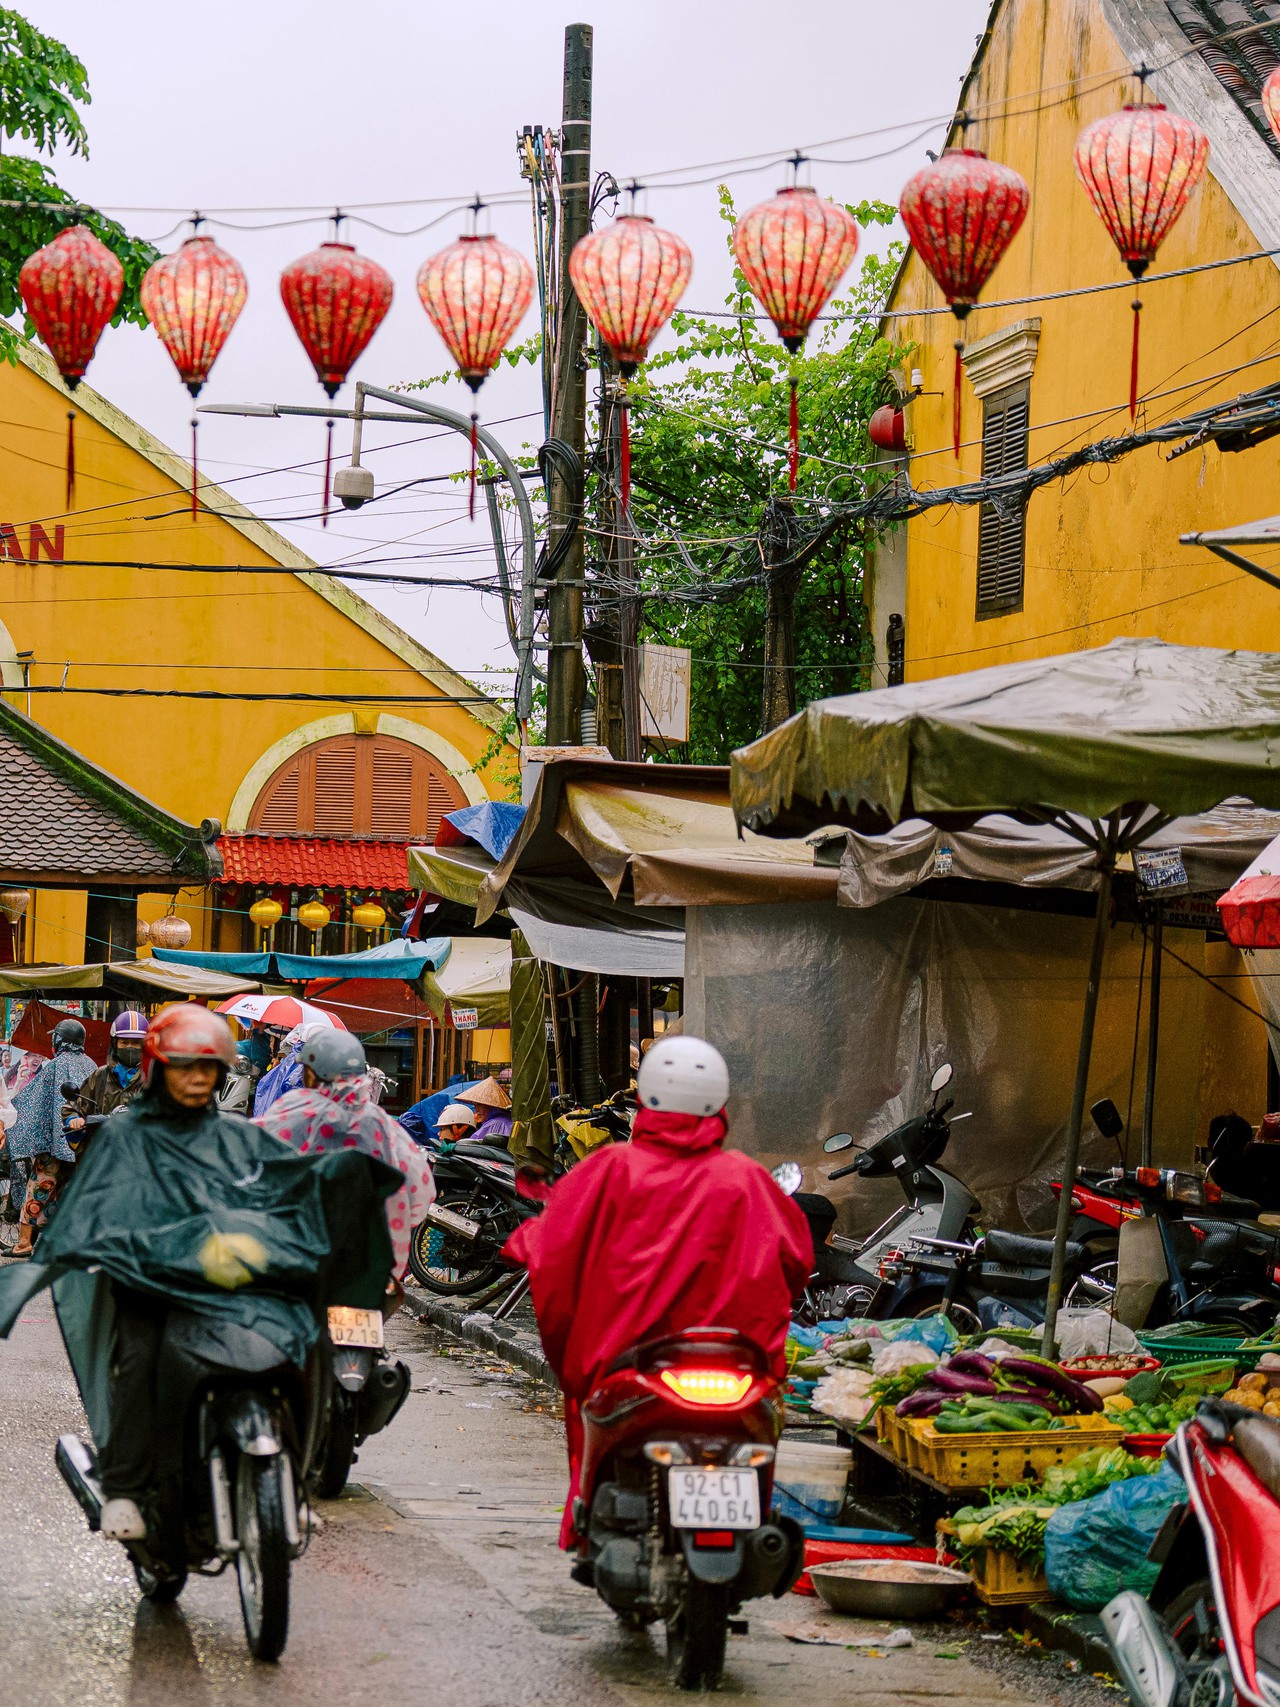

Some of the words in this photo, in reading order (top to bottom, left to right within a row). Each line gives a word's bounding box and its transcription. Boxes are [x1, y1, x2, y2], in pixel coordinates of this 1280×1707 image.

[988, 1264, 1026, 1276] HONDA
[329, 1327, 379, 1345] 02.19
[684, 1474, 741, 1497] 92-C1
[678, 1499, 753, 1523] 440.64
